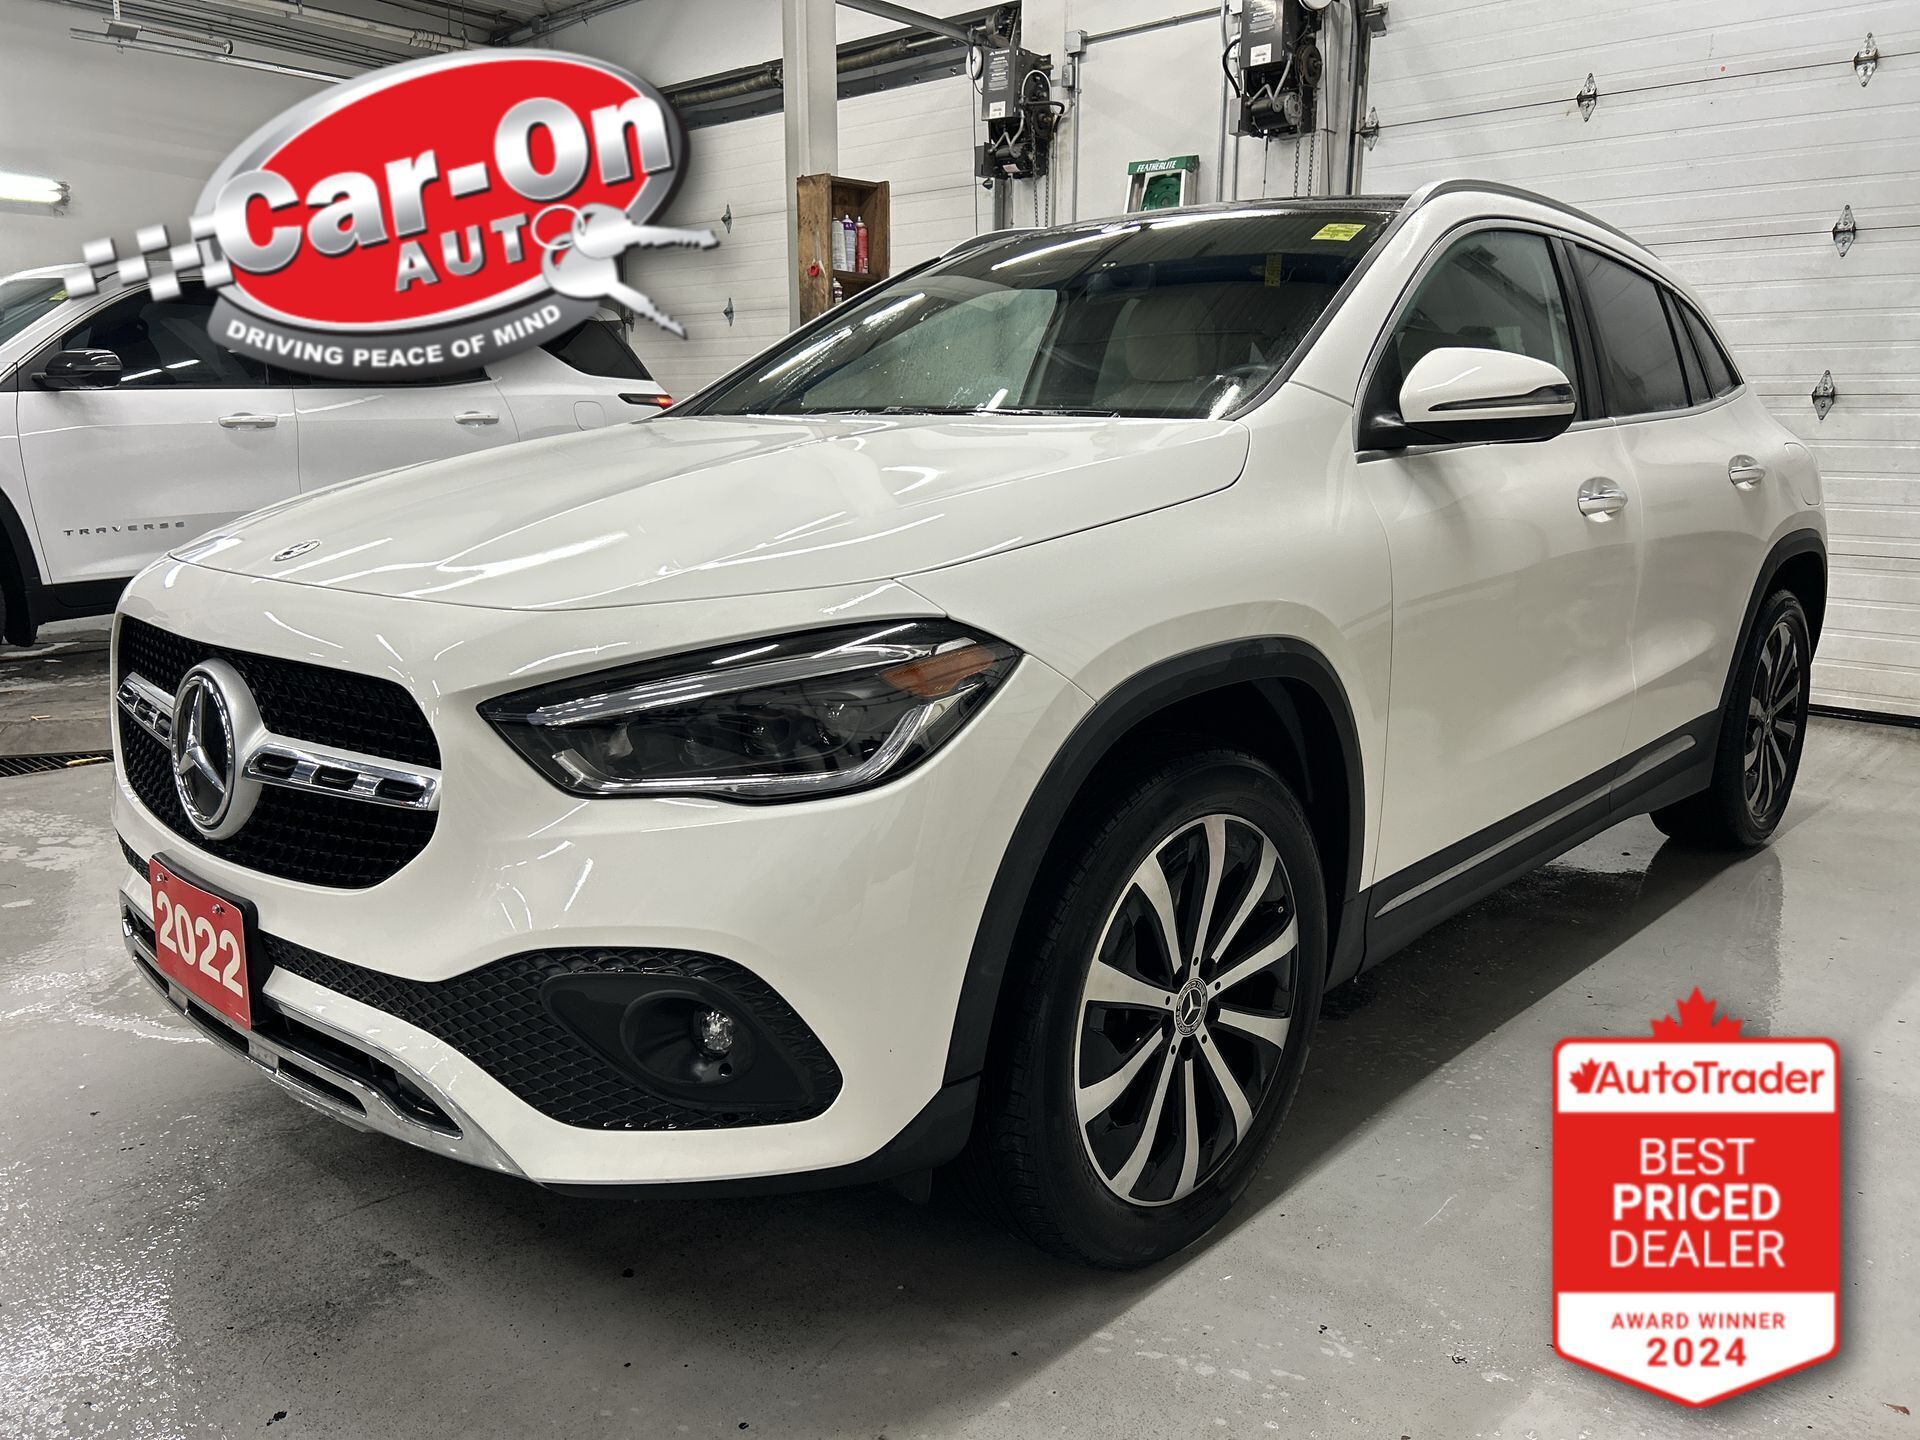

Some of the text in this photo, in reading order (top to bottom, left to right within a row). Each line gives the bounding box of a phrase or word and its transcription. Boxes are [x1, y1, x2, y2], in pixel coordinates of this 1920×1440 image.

[1136, 160, 1178, 173] FEATHERLITE
[63, 521, 185, 536] TRAVERSE
[156, 890, 244, 998] 2022
